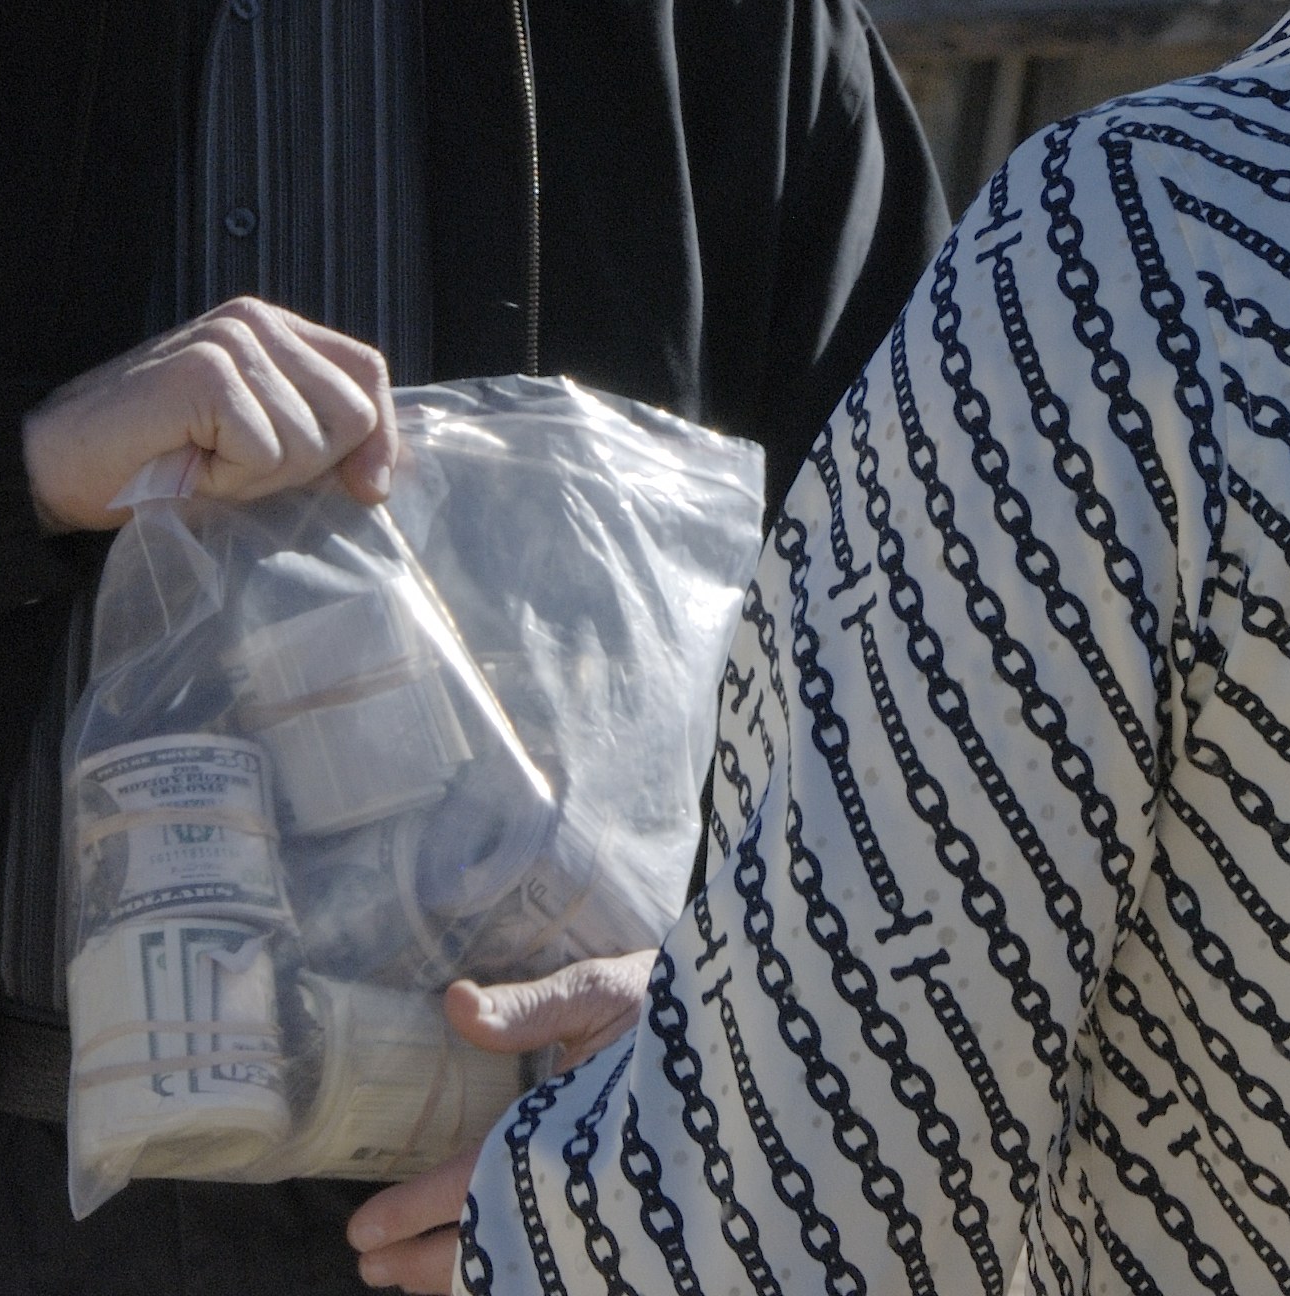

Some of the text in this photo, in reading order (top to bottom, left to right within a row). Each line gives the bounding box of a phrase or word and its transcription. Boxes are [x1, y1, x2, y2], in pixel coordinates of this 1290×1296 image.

[117, 772, 251, 795] MOTION PICTURE
[186, 782, 226, 795] ONLY
